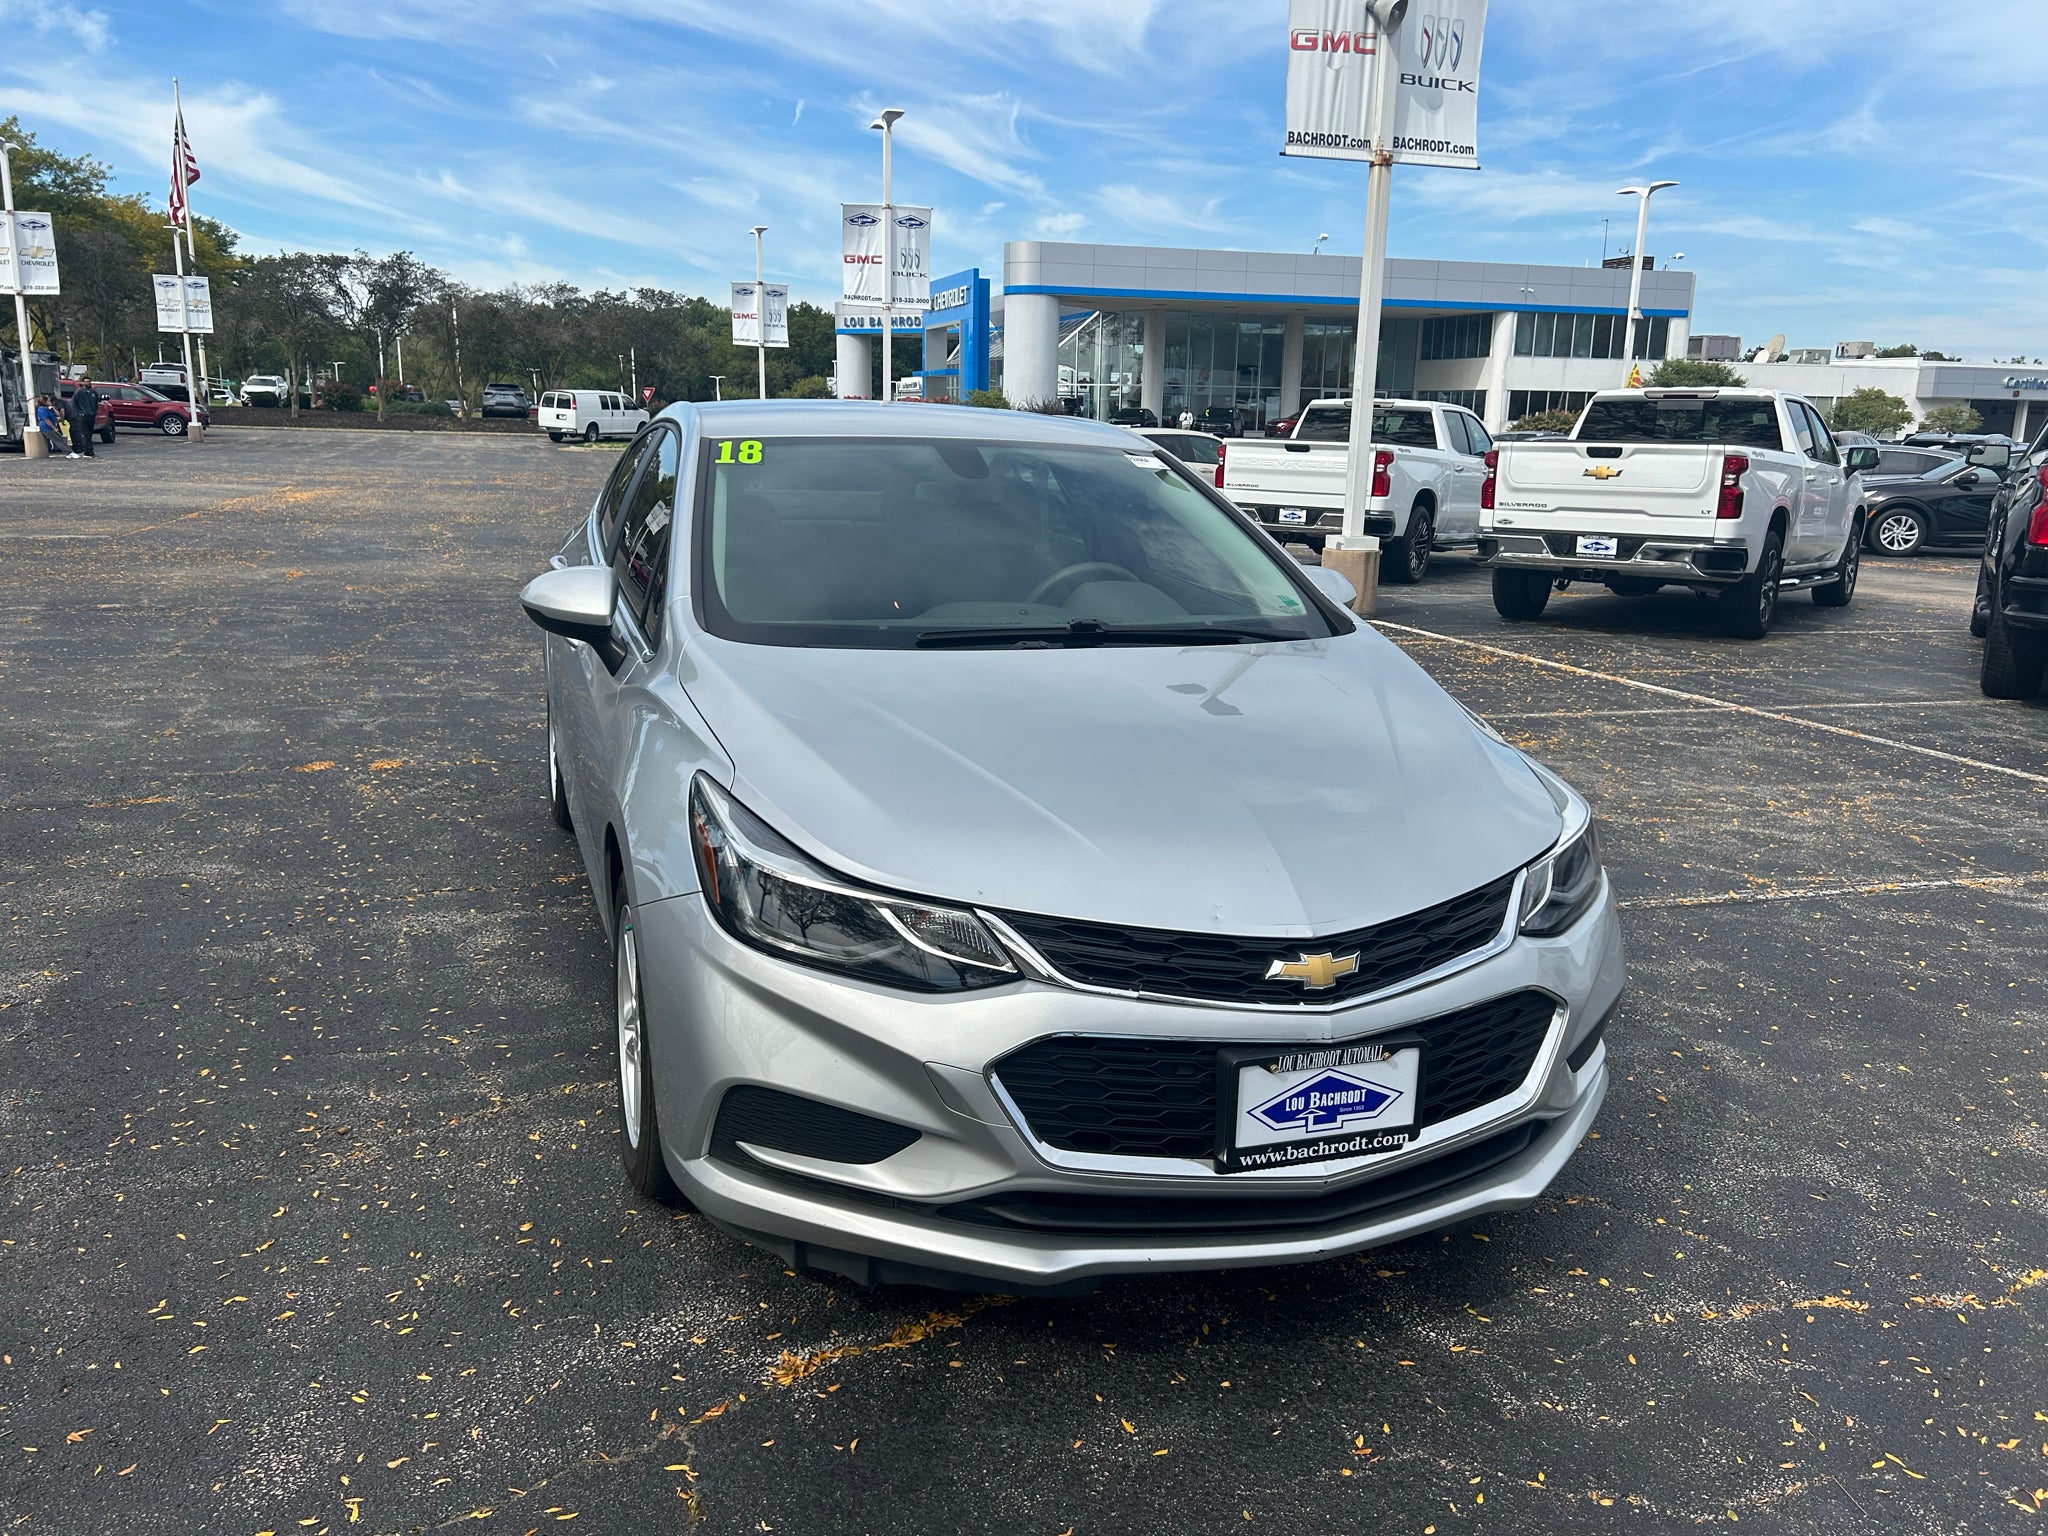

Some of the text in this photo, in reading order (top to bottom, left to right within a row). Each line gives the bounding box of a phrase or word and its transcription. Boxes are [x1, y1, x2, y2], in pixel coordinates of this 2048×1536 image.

[1291, 28, 1377, 55] GMC
[1400, 73, 1475, 93] BUICK
[1288, 131, 1371, 149] BACHRODT.com
[1393, 136, 1474, 155] BACHRODT.com
[844, 254, 882, 264] GMC
[892, 270, 928, 278] BUICK
[844, 294, 882, 302] BACHRODT.com
[934, 284, 968, 311] CHEVROLET
[843, 316, 922, 328] LOU BAHROD
[714, 440, 763, 464] 18
[1233, 457, 1347, 472] CHEVROLE
[1278, 1045, 1383, 1072] LOU BACHRODT AUTOMALL
[1285, 1089, 1367, 1112] LOU BACHRODT
[1239, 1133, 1409, 1167] www.bachrodt.com
